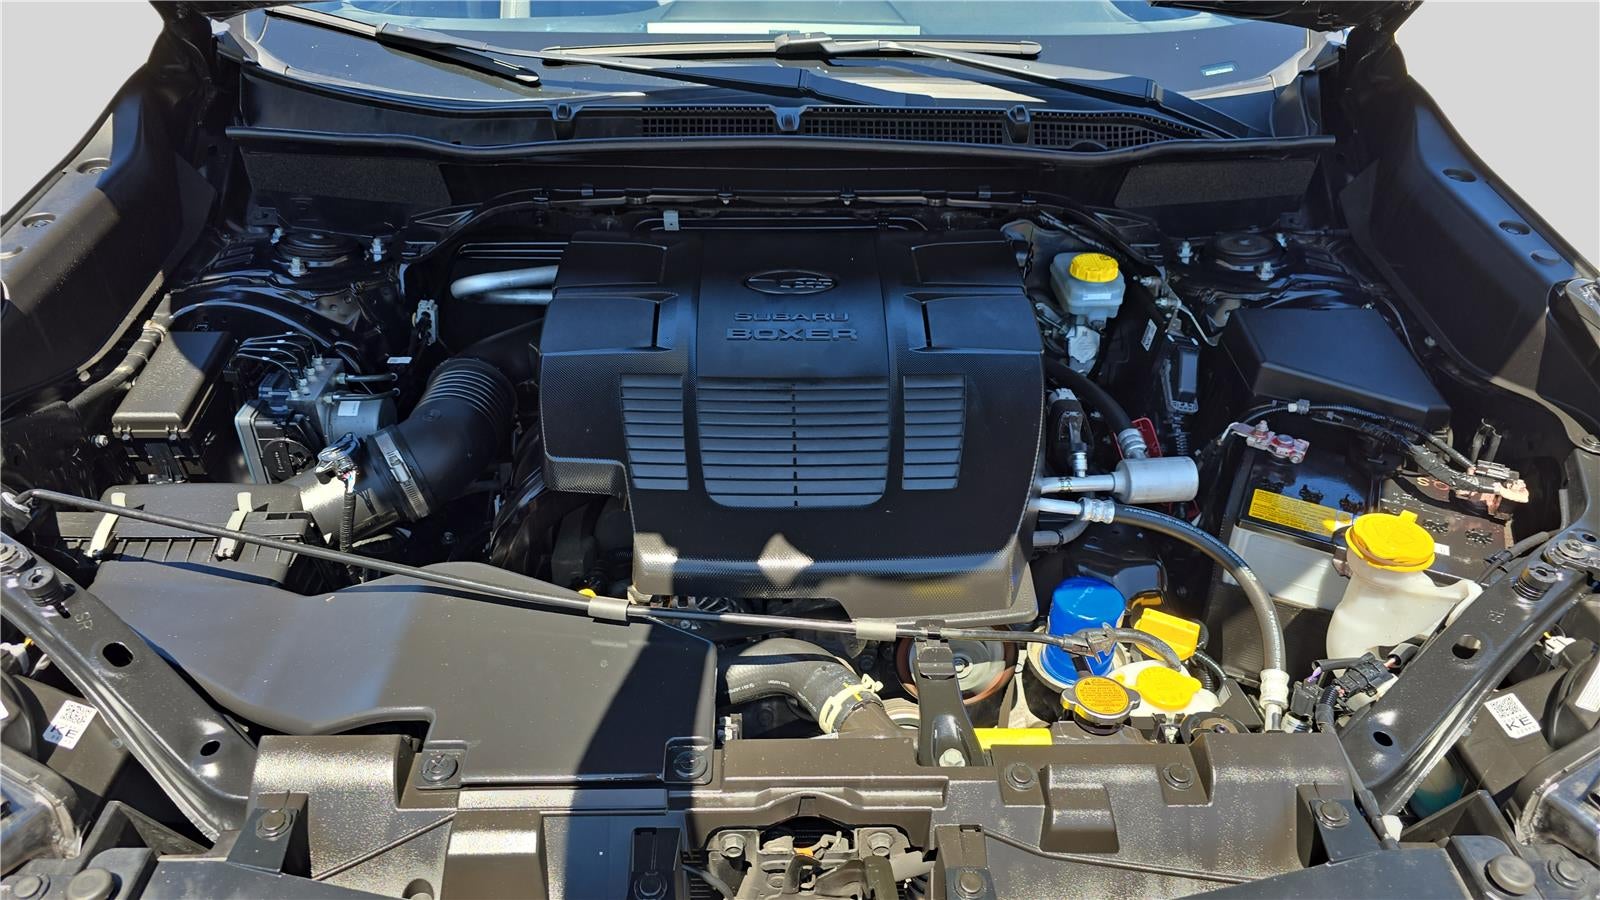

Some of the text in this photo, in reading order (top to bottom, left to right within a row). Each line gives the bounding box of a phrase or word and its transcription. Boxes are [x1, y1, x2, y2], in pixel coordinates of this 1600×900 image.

[734, 311, 849, 322] SUBARU
[726, 328, 858, 341] BOXER
[1505, 716, 1533, 731] KE
[50, 725, 79, 739] KE
